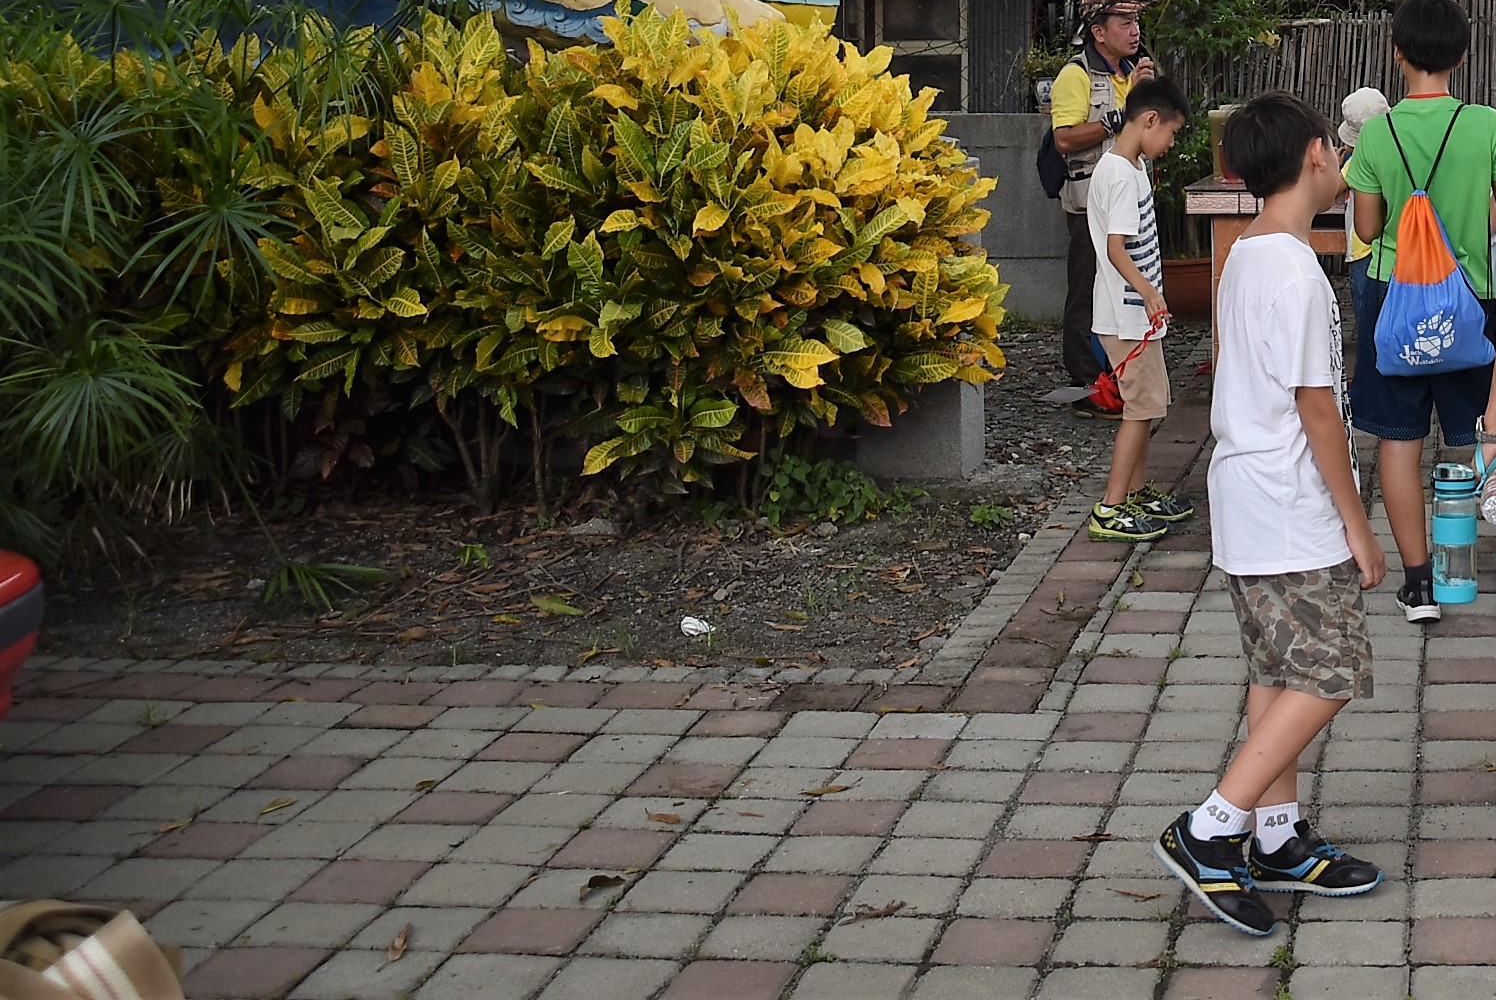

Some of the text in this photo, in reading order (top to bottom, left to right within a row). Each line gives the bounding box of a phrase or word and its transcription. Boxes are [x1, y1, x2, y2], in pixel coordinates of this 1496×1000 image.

[1398, 344, 1424, 360] Jack
[1206, 804, 1231, 824] 40
[1264, 813, 1289, 828] 40
